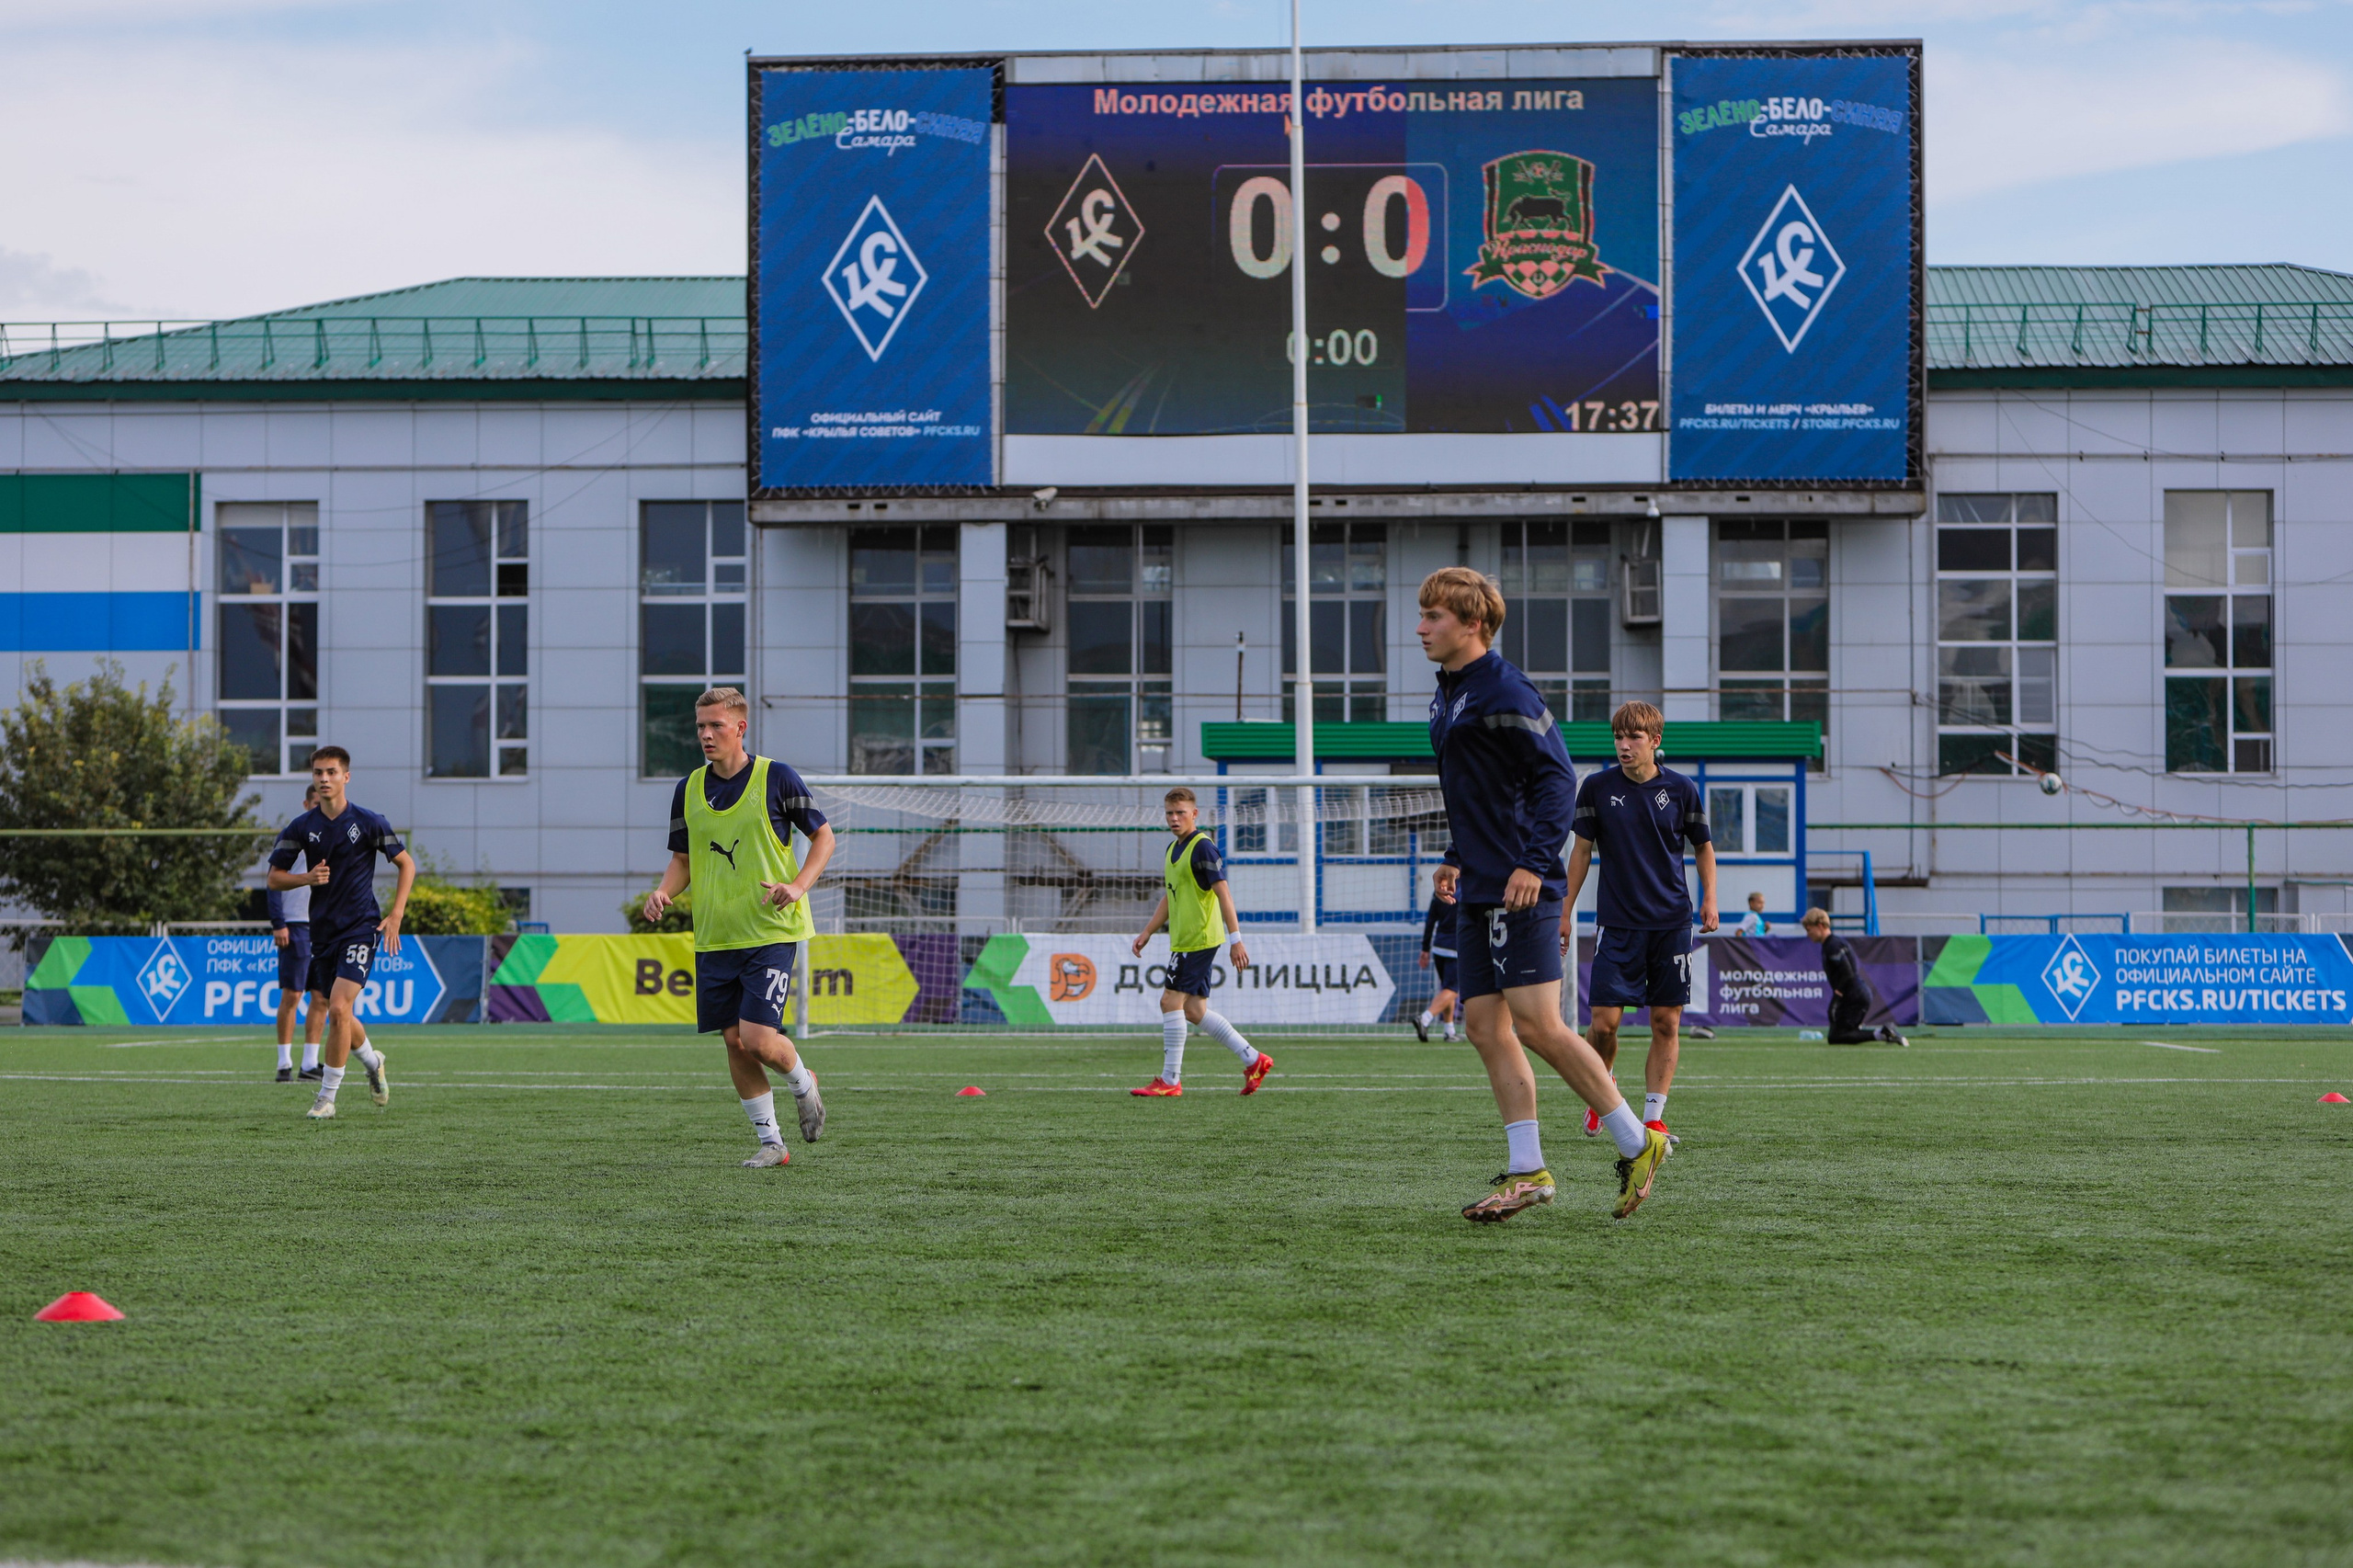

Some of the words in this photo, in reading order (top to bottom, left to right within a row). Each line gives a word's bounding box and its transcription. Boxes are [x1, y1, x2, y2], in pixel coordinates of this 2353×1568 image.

[1094, 88, 1294, 118] Молодежная
[1306, 86, 1503, 118] футбольная
[1511, 89, 1584, 110] лига
[1749, 113, 1833, 146] Самара
[835, 126, 916, 157] Самара
[811, 410, 904, 424] ОФИЦИАЛЬНЫЙ
[908, 409, 942, 422] САЙТ
[1565, 401, 1658, 431] 17:37
[1704, 403, 1755, 415] БИЛЕТЫ
[771, 427, 800, 438] ПФК
[923, 426, 981, 437] PFCKS.RU
[1679, 417, 1790, 430] PFCKS.RU/TICKETS
[1802, 417, 1900, 430] STORE.PFCKS.RU
[346, 944, 369, 965] 58
[2115, 945, 2200, 965] ПОКУПАЙ
[2204, 948, 2278, 965] БИЛЕТЫ
[2282, 949, 2307, 964] НА
[206, 959, 243, 973] ПФК
[2116, 967, 2255, 985] ОФИЦИАЛЬНОМ
[2259, 964, 2316, 984] САЙТЕ
[765, 968, 789, 1003] 79
[1115, 965, 1226, 994] ДОО
[1237, 964, 1377, 994] ПИЦЦА
[1719, 970, 1827, 983] молодежная
[1719, 983, 1823, 1001] футбольная
[2116, 989, 2347, 1011] PFCKS.RU/TICKETS
[1719, 1003, 1759, 1015] лига
